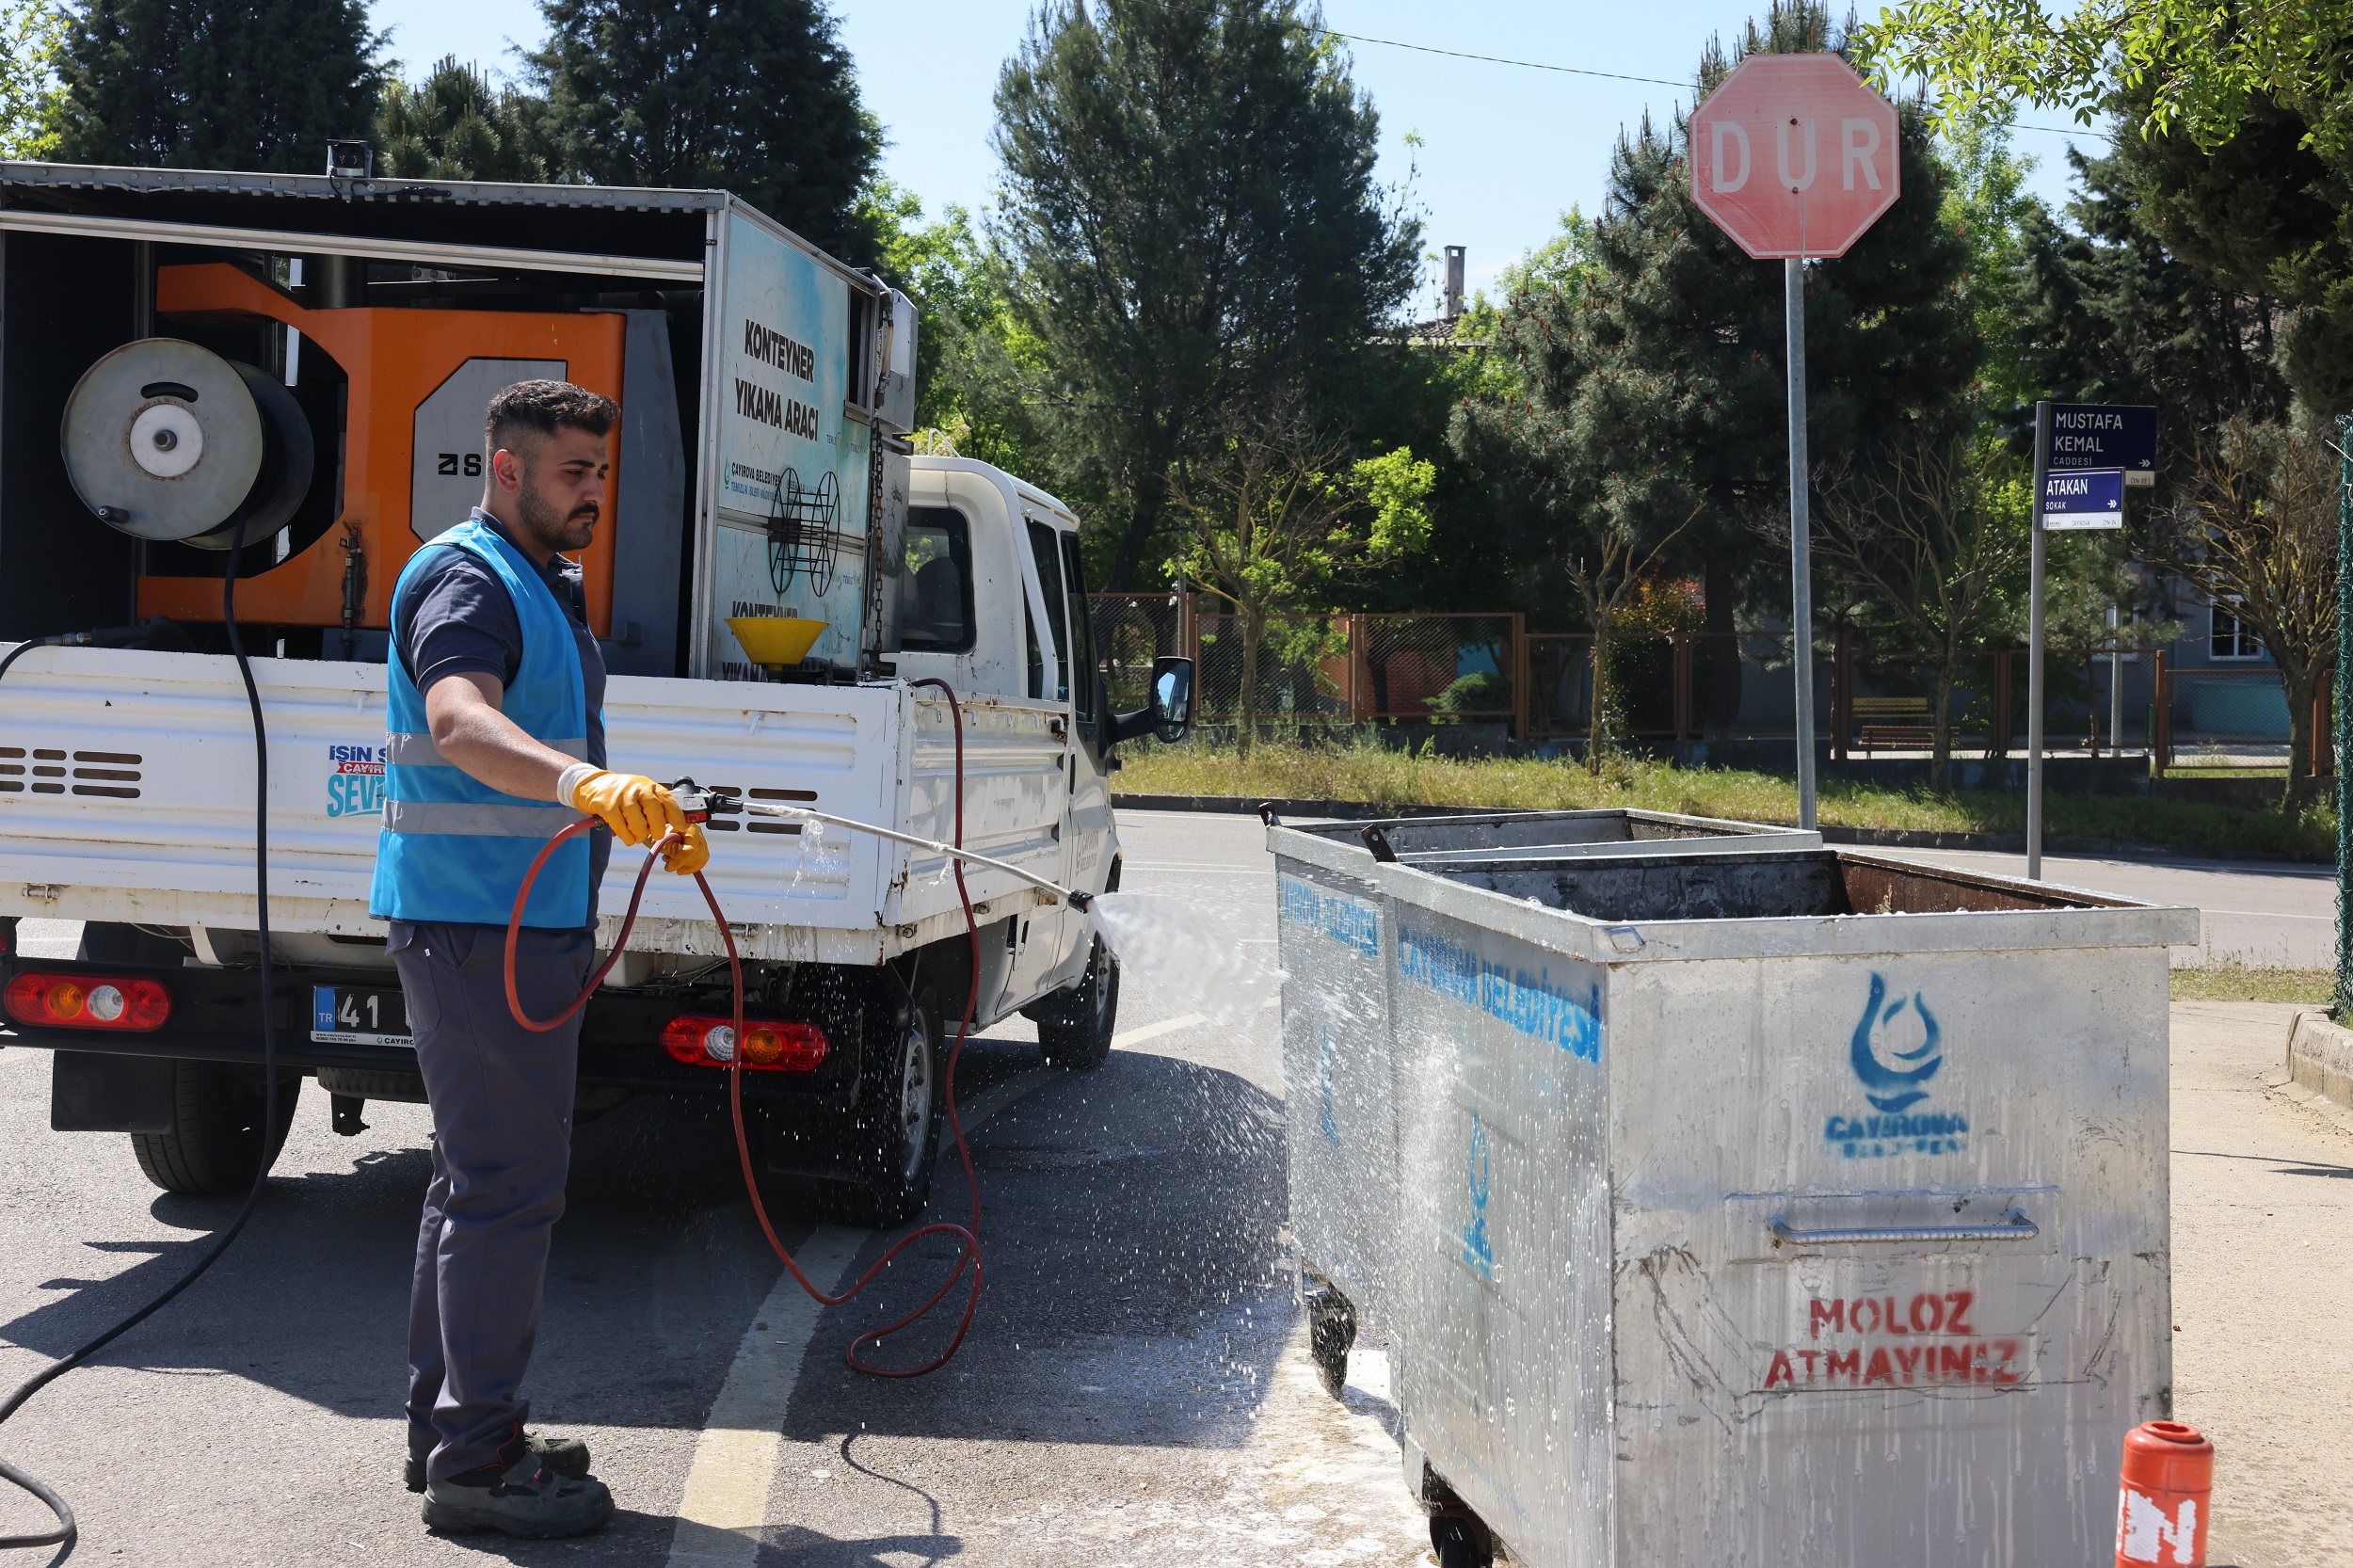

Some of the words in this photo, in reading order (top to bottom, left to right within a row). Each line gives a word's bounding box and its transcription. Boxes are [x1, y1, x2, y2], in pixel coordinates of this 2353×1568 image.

[1711, 118, 1881, 193] DUR
[744, 319, 814, 383] KONTEYNER
[735, 377, 782, 430] YIKAMA
[784, 398, 818, 441] ARACI
[2056, 412, 2122, 429] MUSTAFA
[2055, 436, 2104, 452] KEMAL
[731, 462, 755, 482] ÇAYIROVA
[756, 469, 782, 488] BELEDİYES
[2053, 456, 2092, 466] CADDESİ
[2046, 479, 2088, 496] ATAKAN
[2045, 501, 2066, 510] SOKAK
[343, 763, 386, 774] ÇAYIR
[318, 1013, 332, 1023] TR
[340, 994, 378, 1028] 41
[1482, 960, 1601, 1064] BELEDİYESİ
[1810, 1290, 1975, 1340] MOLOZ
[1764, 1339, 2024, 1388] ATMAYINIZ
